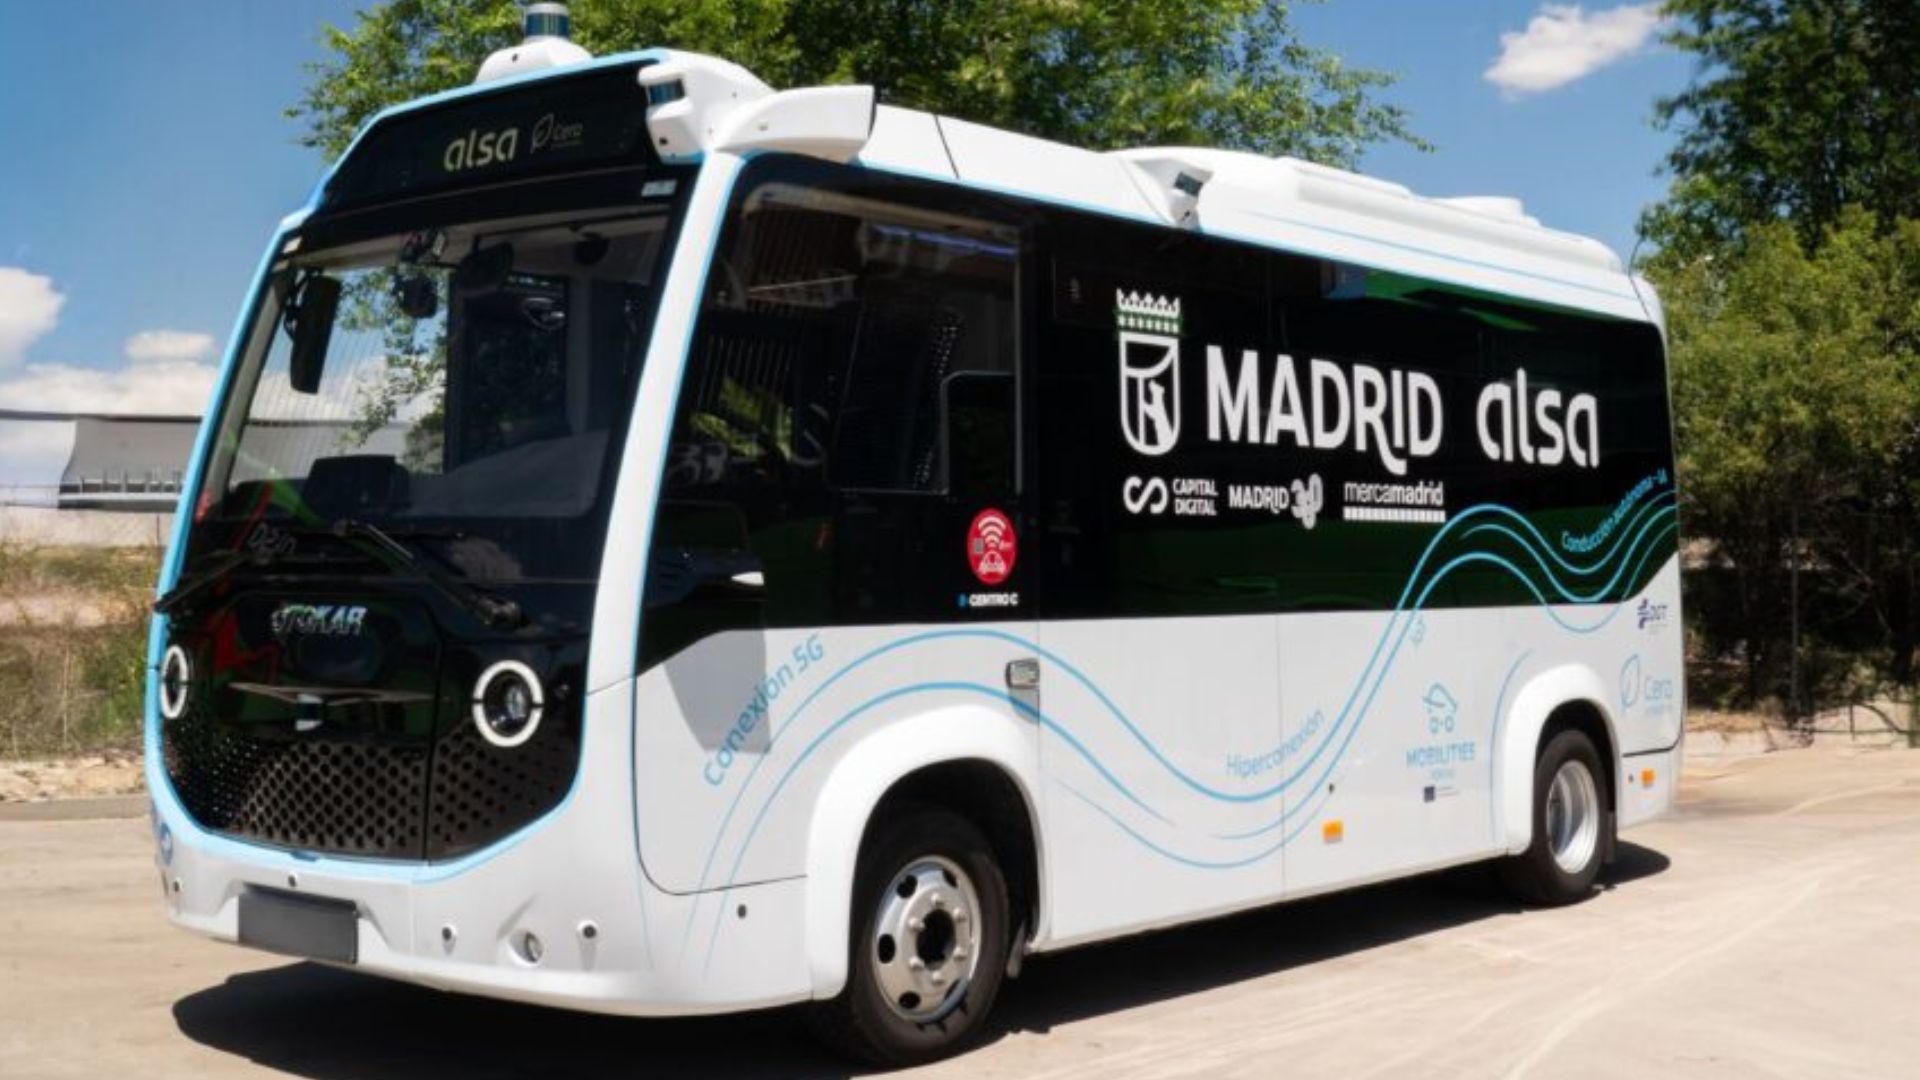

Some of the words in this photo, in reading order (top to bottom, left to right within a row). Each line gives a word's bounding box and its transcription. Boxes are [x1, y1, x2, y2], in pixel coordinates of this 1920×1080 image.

[444, 127, 518, 171] alsa
[1206, 345, 1443, 476] MADRID
[1477, 368, 1599, 468] alsa
[1172, 478, 1219, 496] CAPITAL
[1228, 484, 1289, 514] MADRID
[1344, 480, 1444, 507] mercamadrid
[1174, 498, 1217, 516] DIGITAL
[704, 664, 794, 786] Conexión
[793, 633, 824, 672] 5G
